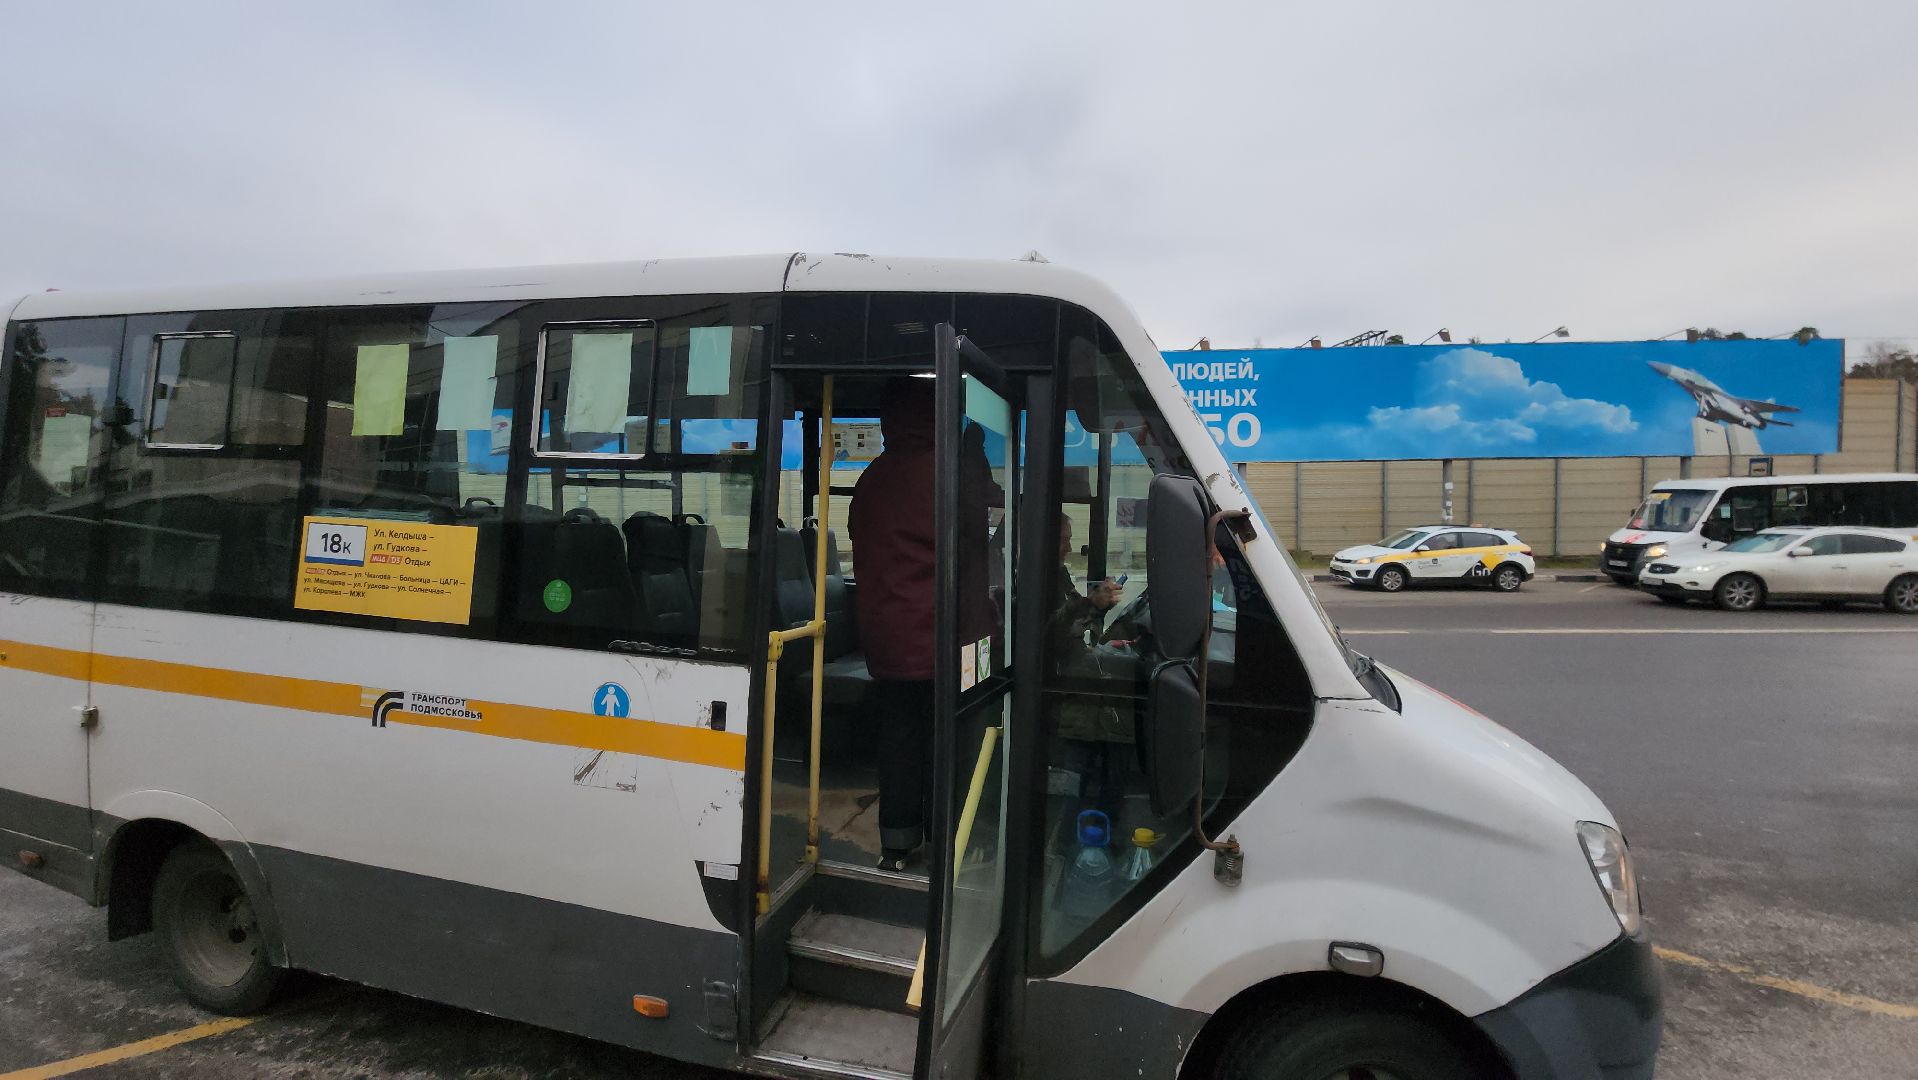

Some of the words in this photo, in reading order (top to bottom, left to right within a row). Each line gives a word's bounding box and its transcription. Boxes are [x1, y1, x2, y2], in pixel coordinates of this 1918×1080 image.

[1172, 357, 1261, 382] ЛЮДЕЙ,
[1185, 388, 1258, 408] ННЫХ
[374, 528, 386, 538] Ул.
[388, 530, 427, 541] Келдыша
[373, 543, 385, 551] ул.
[386, 542, 420, 553] Гудкова
[404, 556, 431, 567] Отдых
[399, 574, 431, 584] Больница
[439, 578, 458, 586] ЦАГИ
[411, 693, 467, 707] ТРАНСПОРТ
[410, 703, 483, 720] ПОДМОСКОВЬЯ
